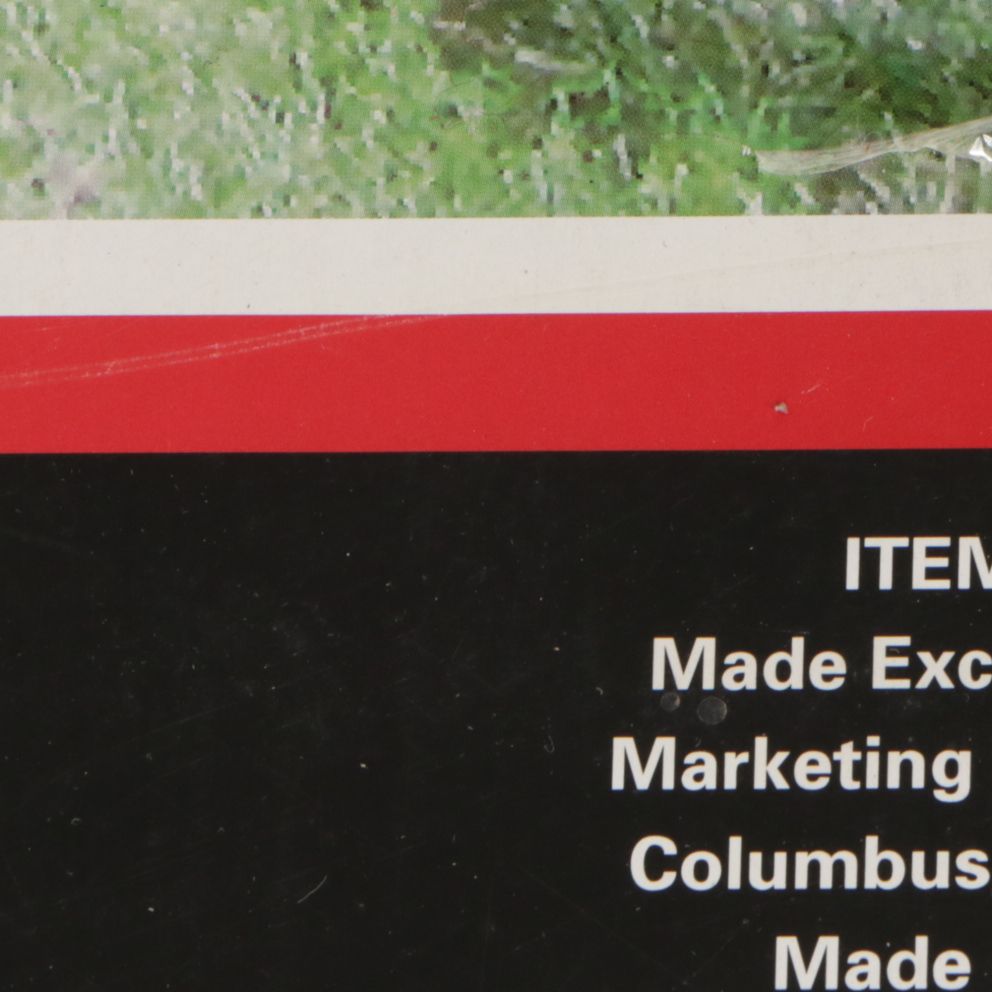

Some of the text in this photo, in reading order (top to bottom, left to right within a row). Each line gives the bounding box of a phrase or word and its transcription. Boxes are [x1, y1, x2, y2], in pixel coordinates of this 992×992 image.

[652, 637, 846, 691] Made
[612, 736, 971, 803] Marketing
[775, 936, 971, 990] Made
